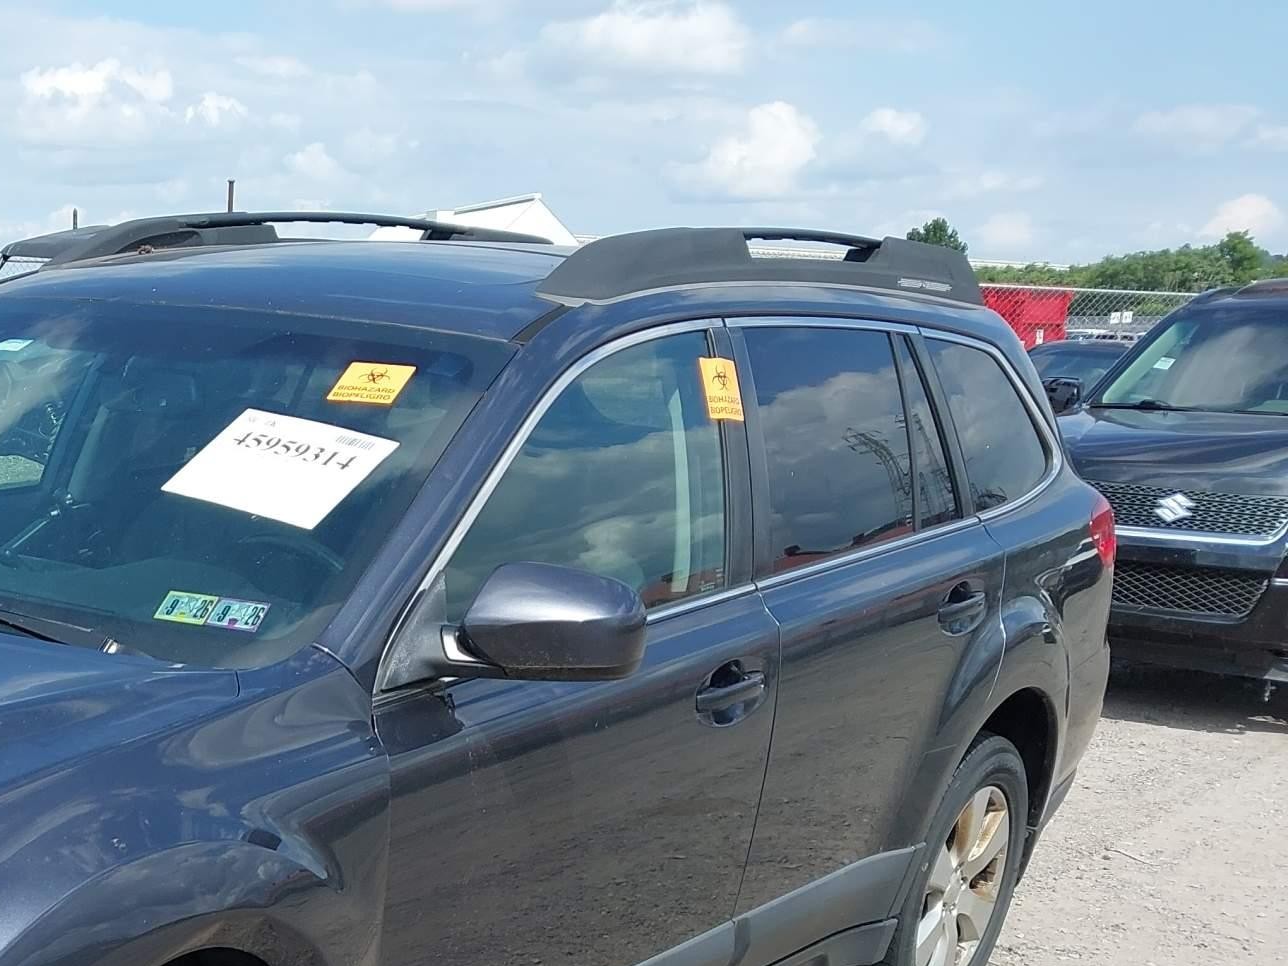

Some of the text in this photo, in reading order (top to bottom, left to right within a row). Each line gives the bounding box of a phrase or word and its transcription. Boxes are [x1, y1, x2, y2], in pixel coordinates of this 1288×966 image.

[337, 385, 396, 394] BIOHAZARD
[332, 392, 391, 401] BIOPELIGRO
[233, 431, 358, 471] 45959314
